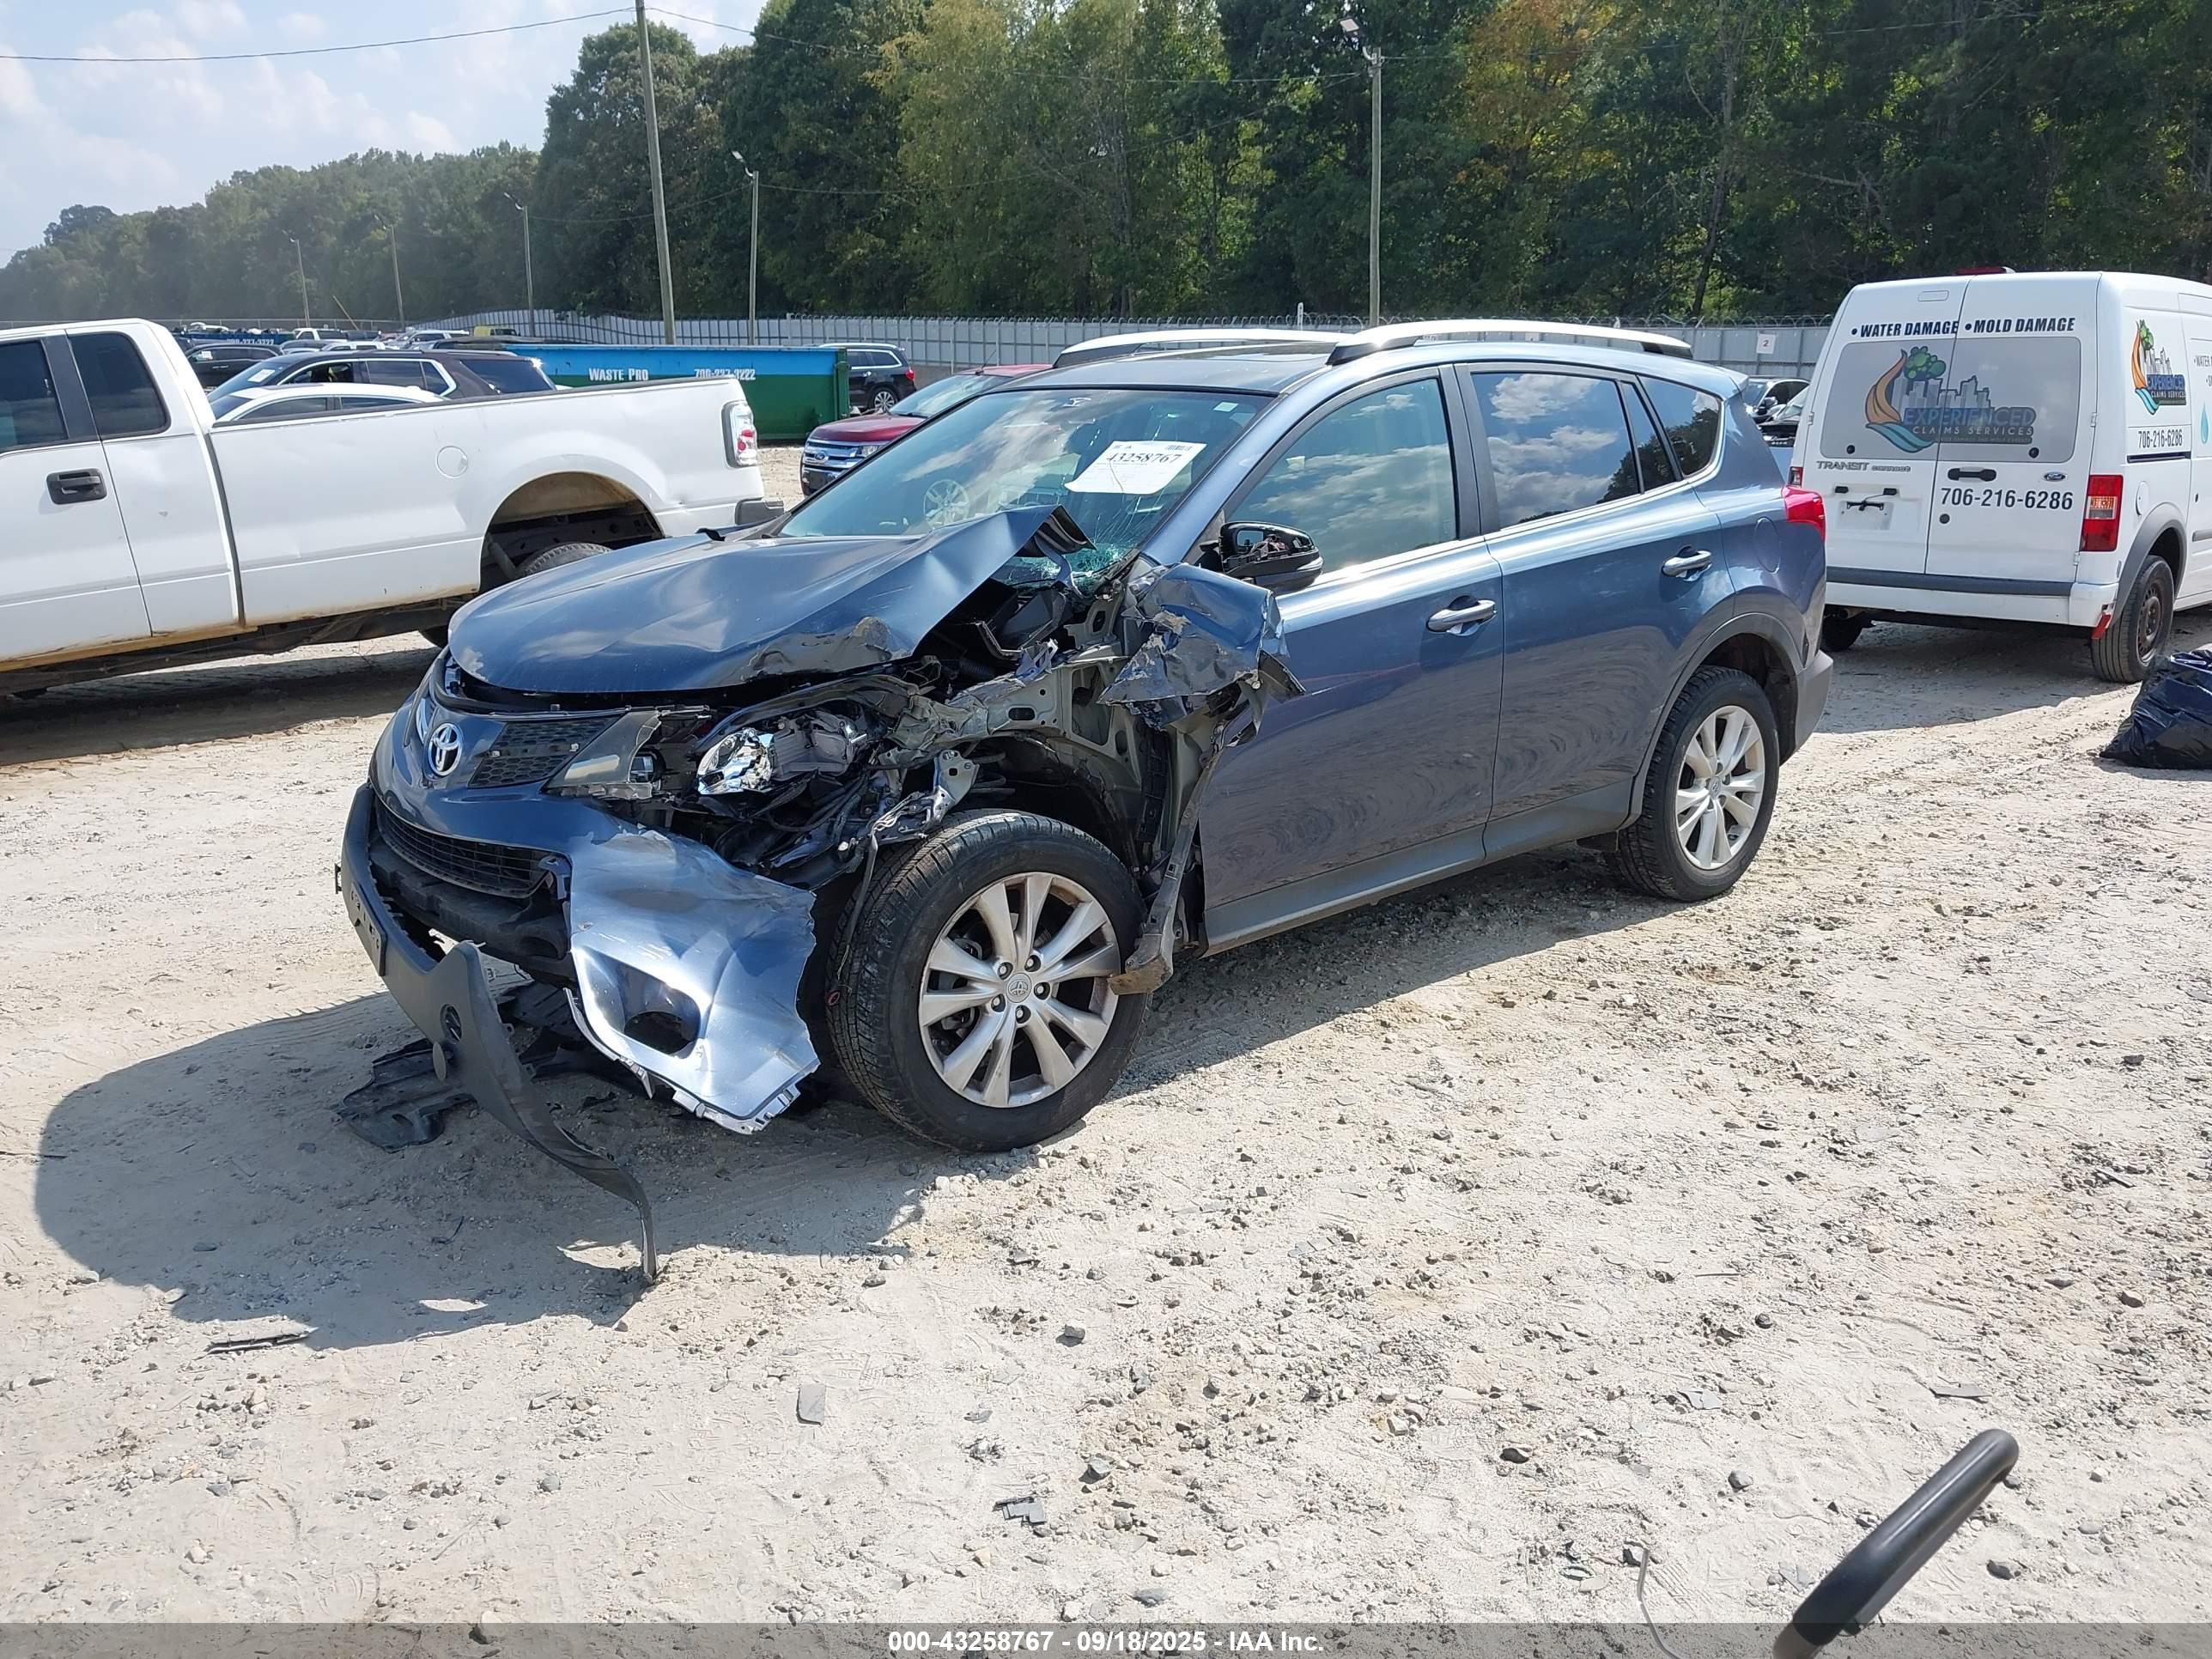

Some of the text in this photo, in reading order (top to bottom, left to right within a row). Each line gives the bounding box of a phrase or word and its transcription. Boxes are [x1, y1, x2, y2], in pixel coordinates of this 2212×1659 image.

[1860, 318, 2075, 337] WATER DAMAGE MOLD DAMAGE
[589, 368, 649, 381] WASTE PRO
[1904, 408, 2035, 428] EXPERIENCED
[1912, 426, 2033, 436] CLAIMS SERVICES
[2138, 429, 2183, 448] 706-216-6286
[1107, 453, 1182, 464] 43258767
[1816, 460, 1870, 471] TRANSIT
[1941, 487, 2074, 510] 706-216-6286
